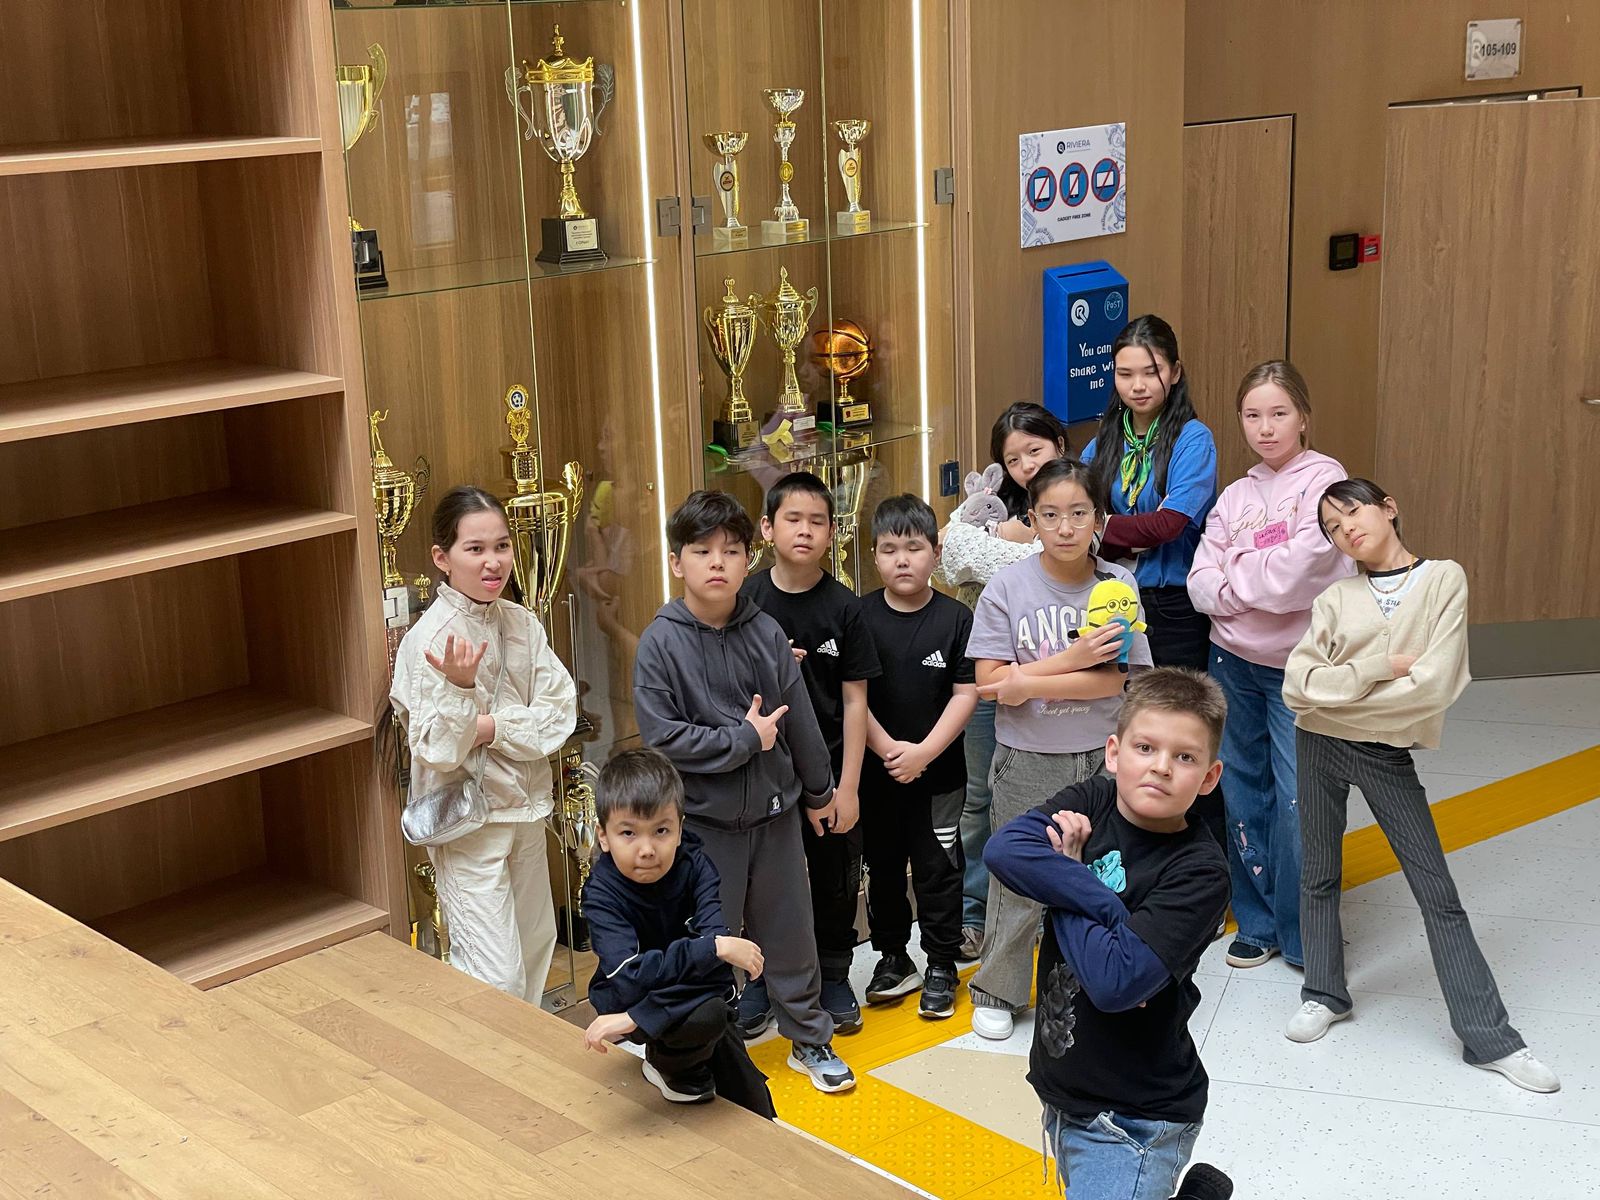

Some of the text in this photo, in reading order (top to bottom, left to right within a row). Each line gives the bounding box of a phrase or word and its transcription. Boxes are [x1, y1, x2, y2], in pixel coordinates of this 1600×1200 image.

[1481, 43, 1516, 56] 105-109
[1066, 139, 1091, 149] RIVIERA
[1079, 342, 1111, 357] You can
[1090, 378, 1105, 390] me
[817, 647, 839, 657] adidas
[922, 659, 946, 668] adidas
